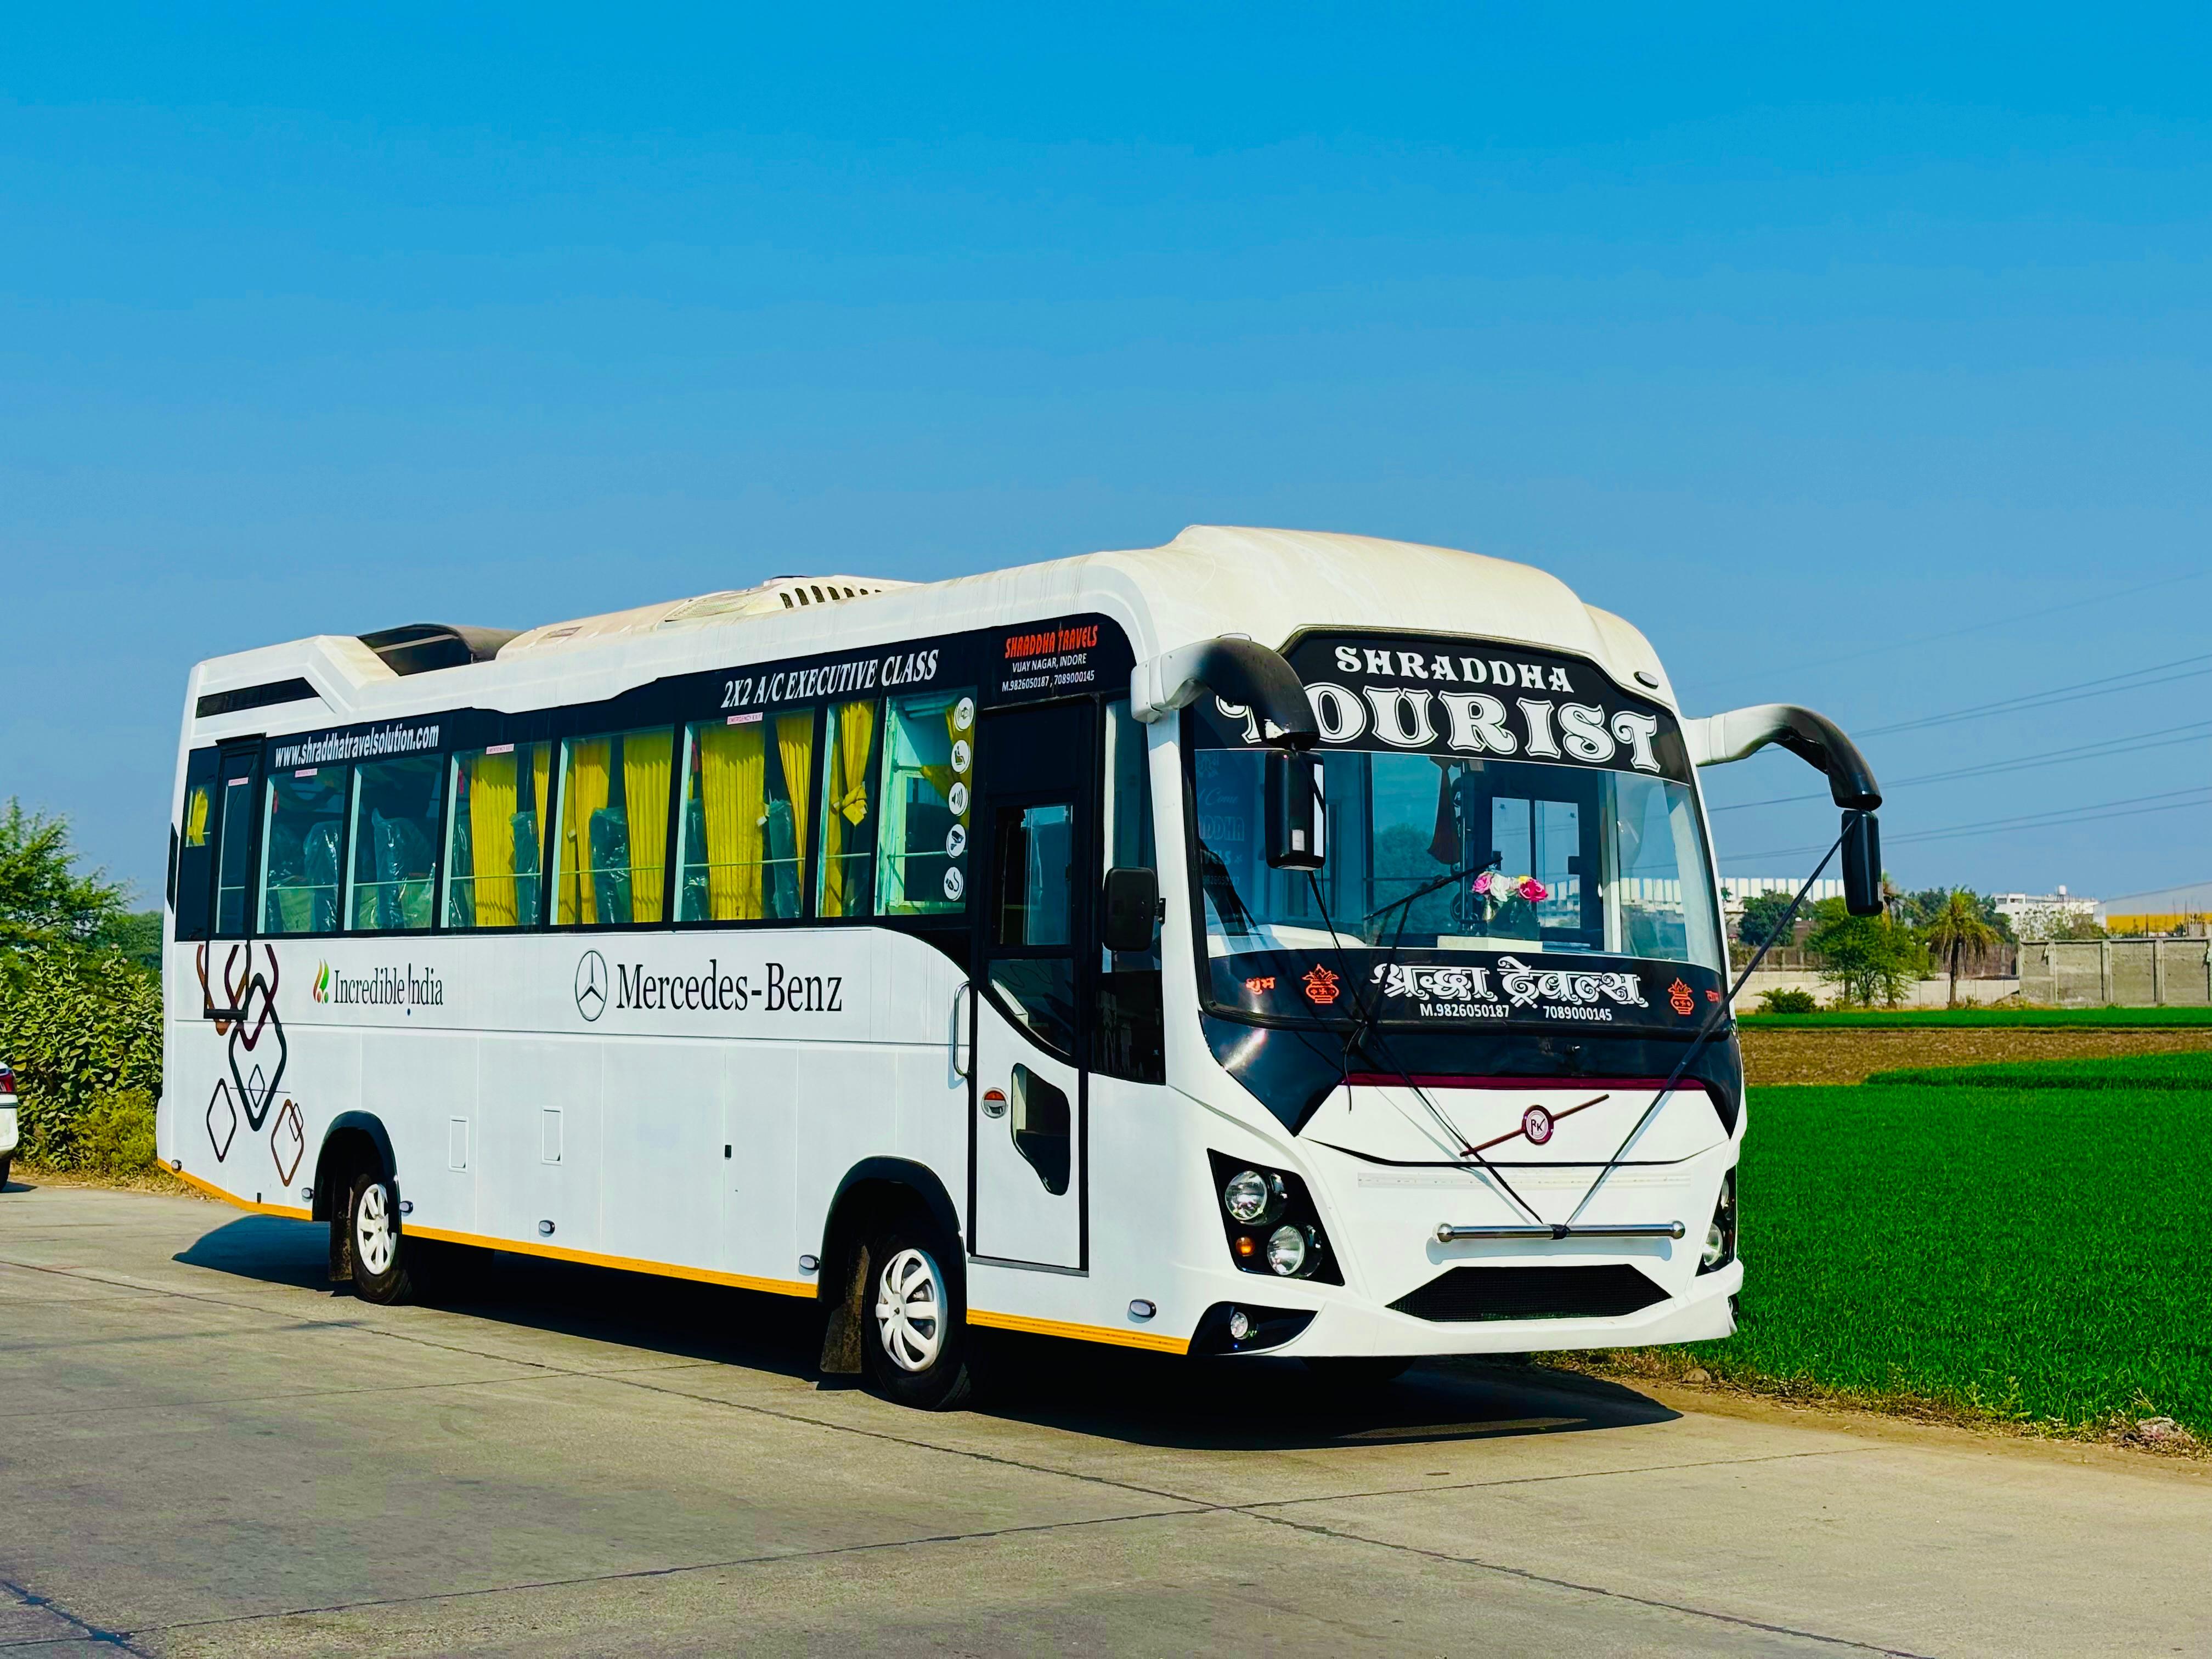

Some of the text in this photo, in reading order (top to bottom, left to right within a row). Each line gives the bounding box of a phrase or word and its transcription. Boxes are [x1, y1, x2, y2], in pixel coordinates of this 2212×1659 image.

[1005, 624, 1098, 659] SHRADDHA TRAVELS
[720, 649, 939, 708] 2X2 A/C EXECUTIVE CLASS
[1002, 675, 1049, 692] M.9826050187
[1054, 670, 1095, 685] 7089000145
[1012, 653, 1087, 673] VIJAY NAGAR, INDORE
[1335, 646, 1575, 693] SHRADDHA
[275, 723, 439, 768] www.shraddhatravelsolution.com
[334, 967, 405, 1005] Incredible
[616, 959, 842, 1012] Mercedes-Benz
[1419, 1003, 1612, 1022] M.9826050187 7089000145
